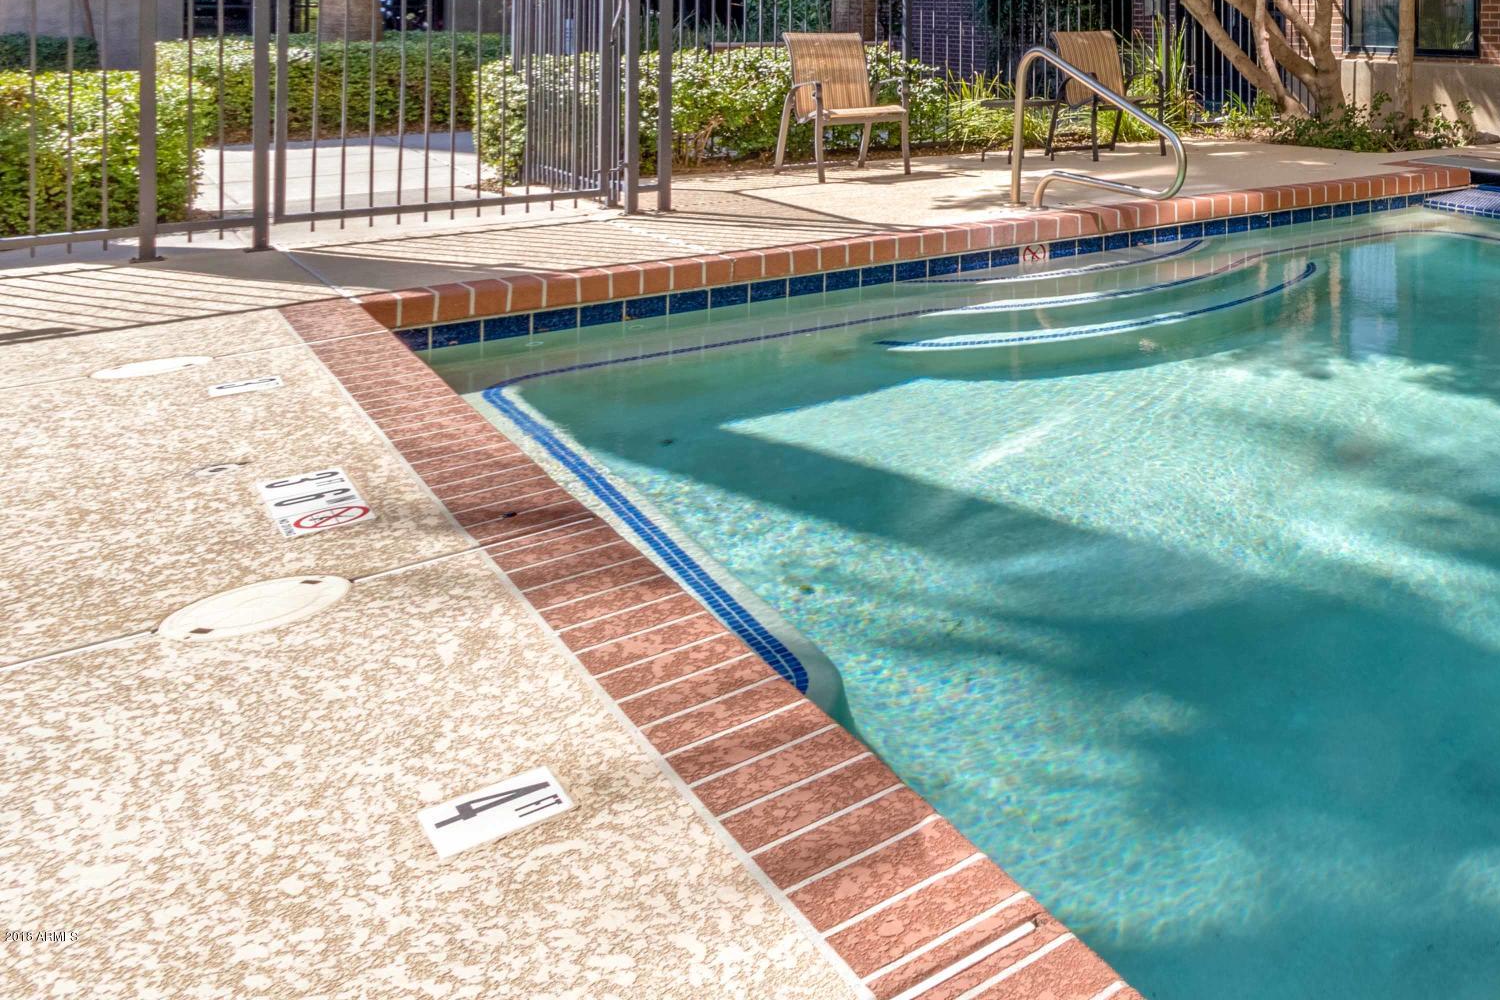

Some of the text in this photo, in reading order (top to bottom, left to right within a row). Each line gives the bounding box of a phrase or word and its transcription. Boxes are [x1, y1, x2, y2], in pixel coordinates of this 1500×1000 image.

[265, 471, 339, 489] 3
[274, 488, 351, 507] 6
[434, 781, 563, 829] 4 FT
